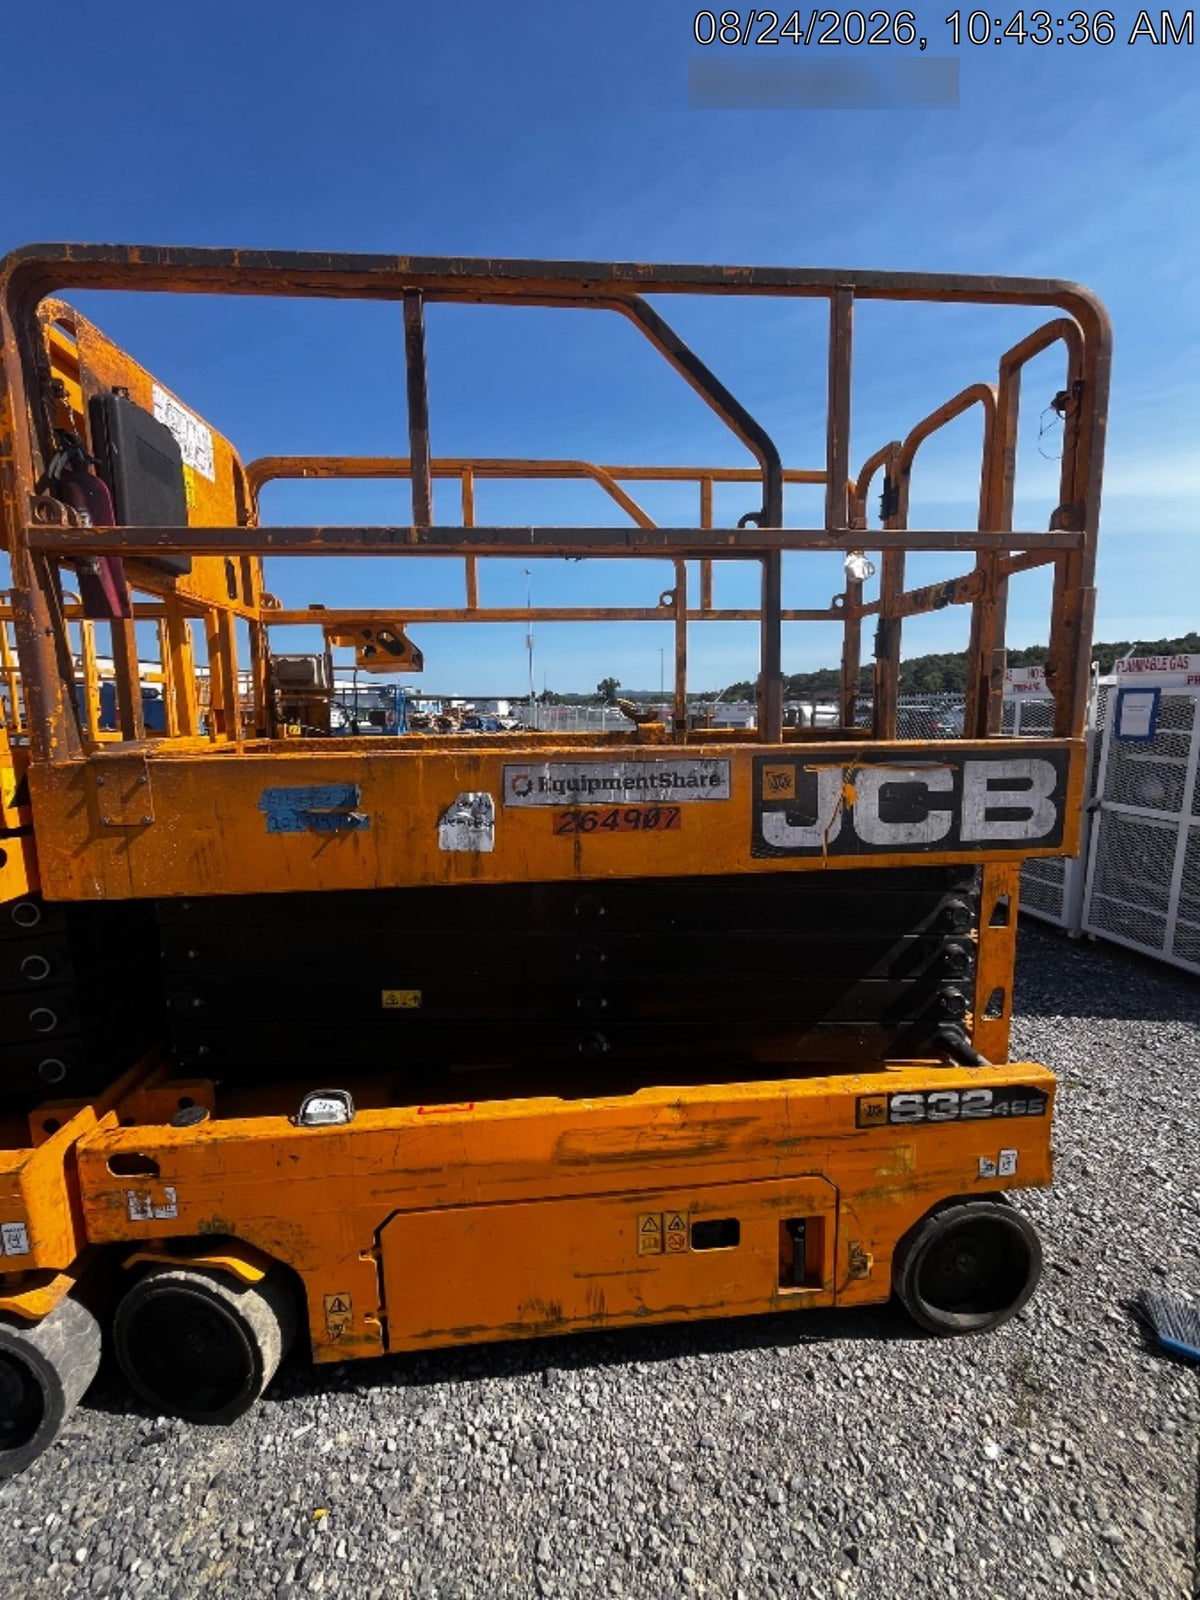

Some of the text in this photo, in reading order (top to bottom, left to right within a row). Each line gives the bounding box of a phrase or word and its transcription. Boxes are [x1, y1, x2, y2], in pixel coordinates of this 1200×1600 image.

[1116, 655, 1189, 673] FLAMMABLE GAS
[537, 772, 722, 796] EquipmentShare
[762, 759, 1057, 847] JCB
[555, 806, 680, 835] 264907
